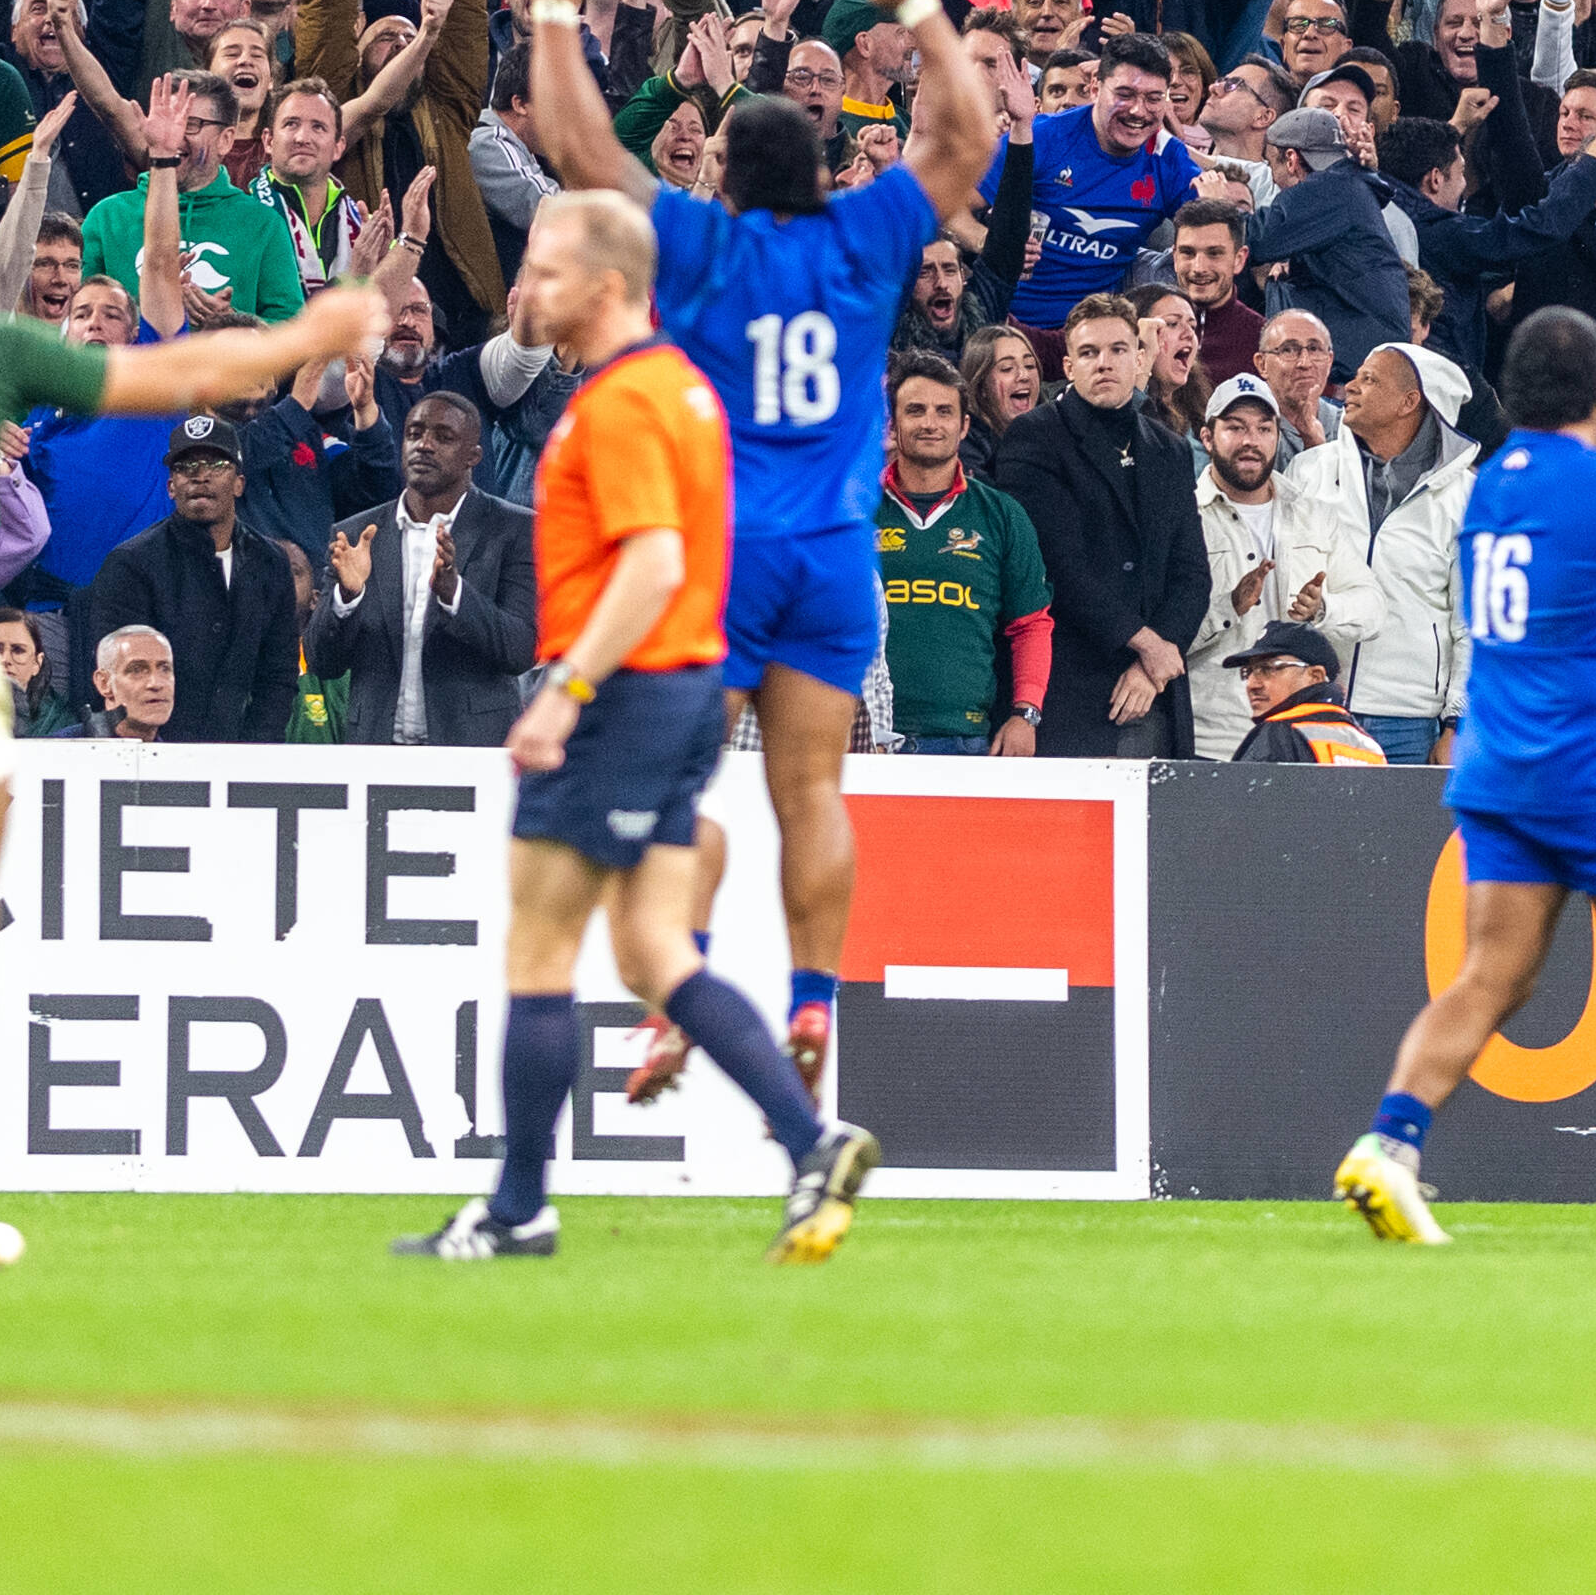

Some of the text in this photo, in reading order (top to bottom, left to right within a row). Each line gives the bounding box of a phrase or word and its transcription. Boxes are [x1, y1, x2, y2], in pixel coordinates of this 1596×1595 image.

[1046, 228, 1118, 261] LTRAD
[746, 310, 841, 427] 18
[1237, 378, 1256, 392] LA
[1472, 532, 1533, 643] 16
